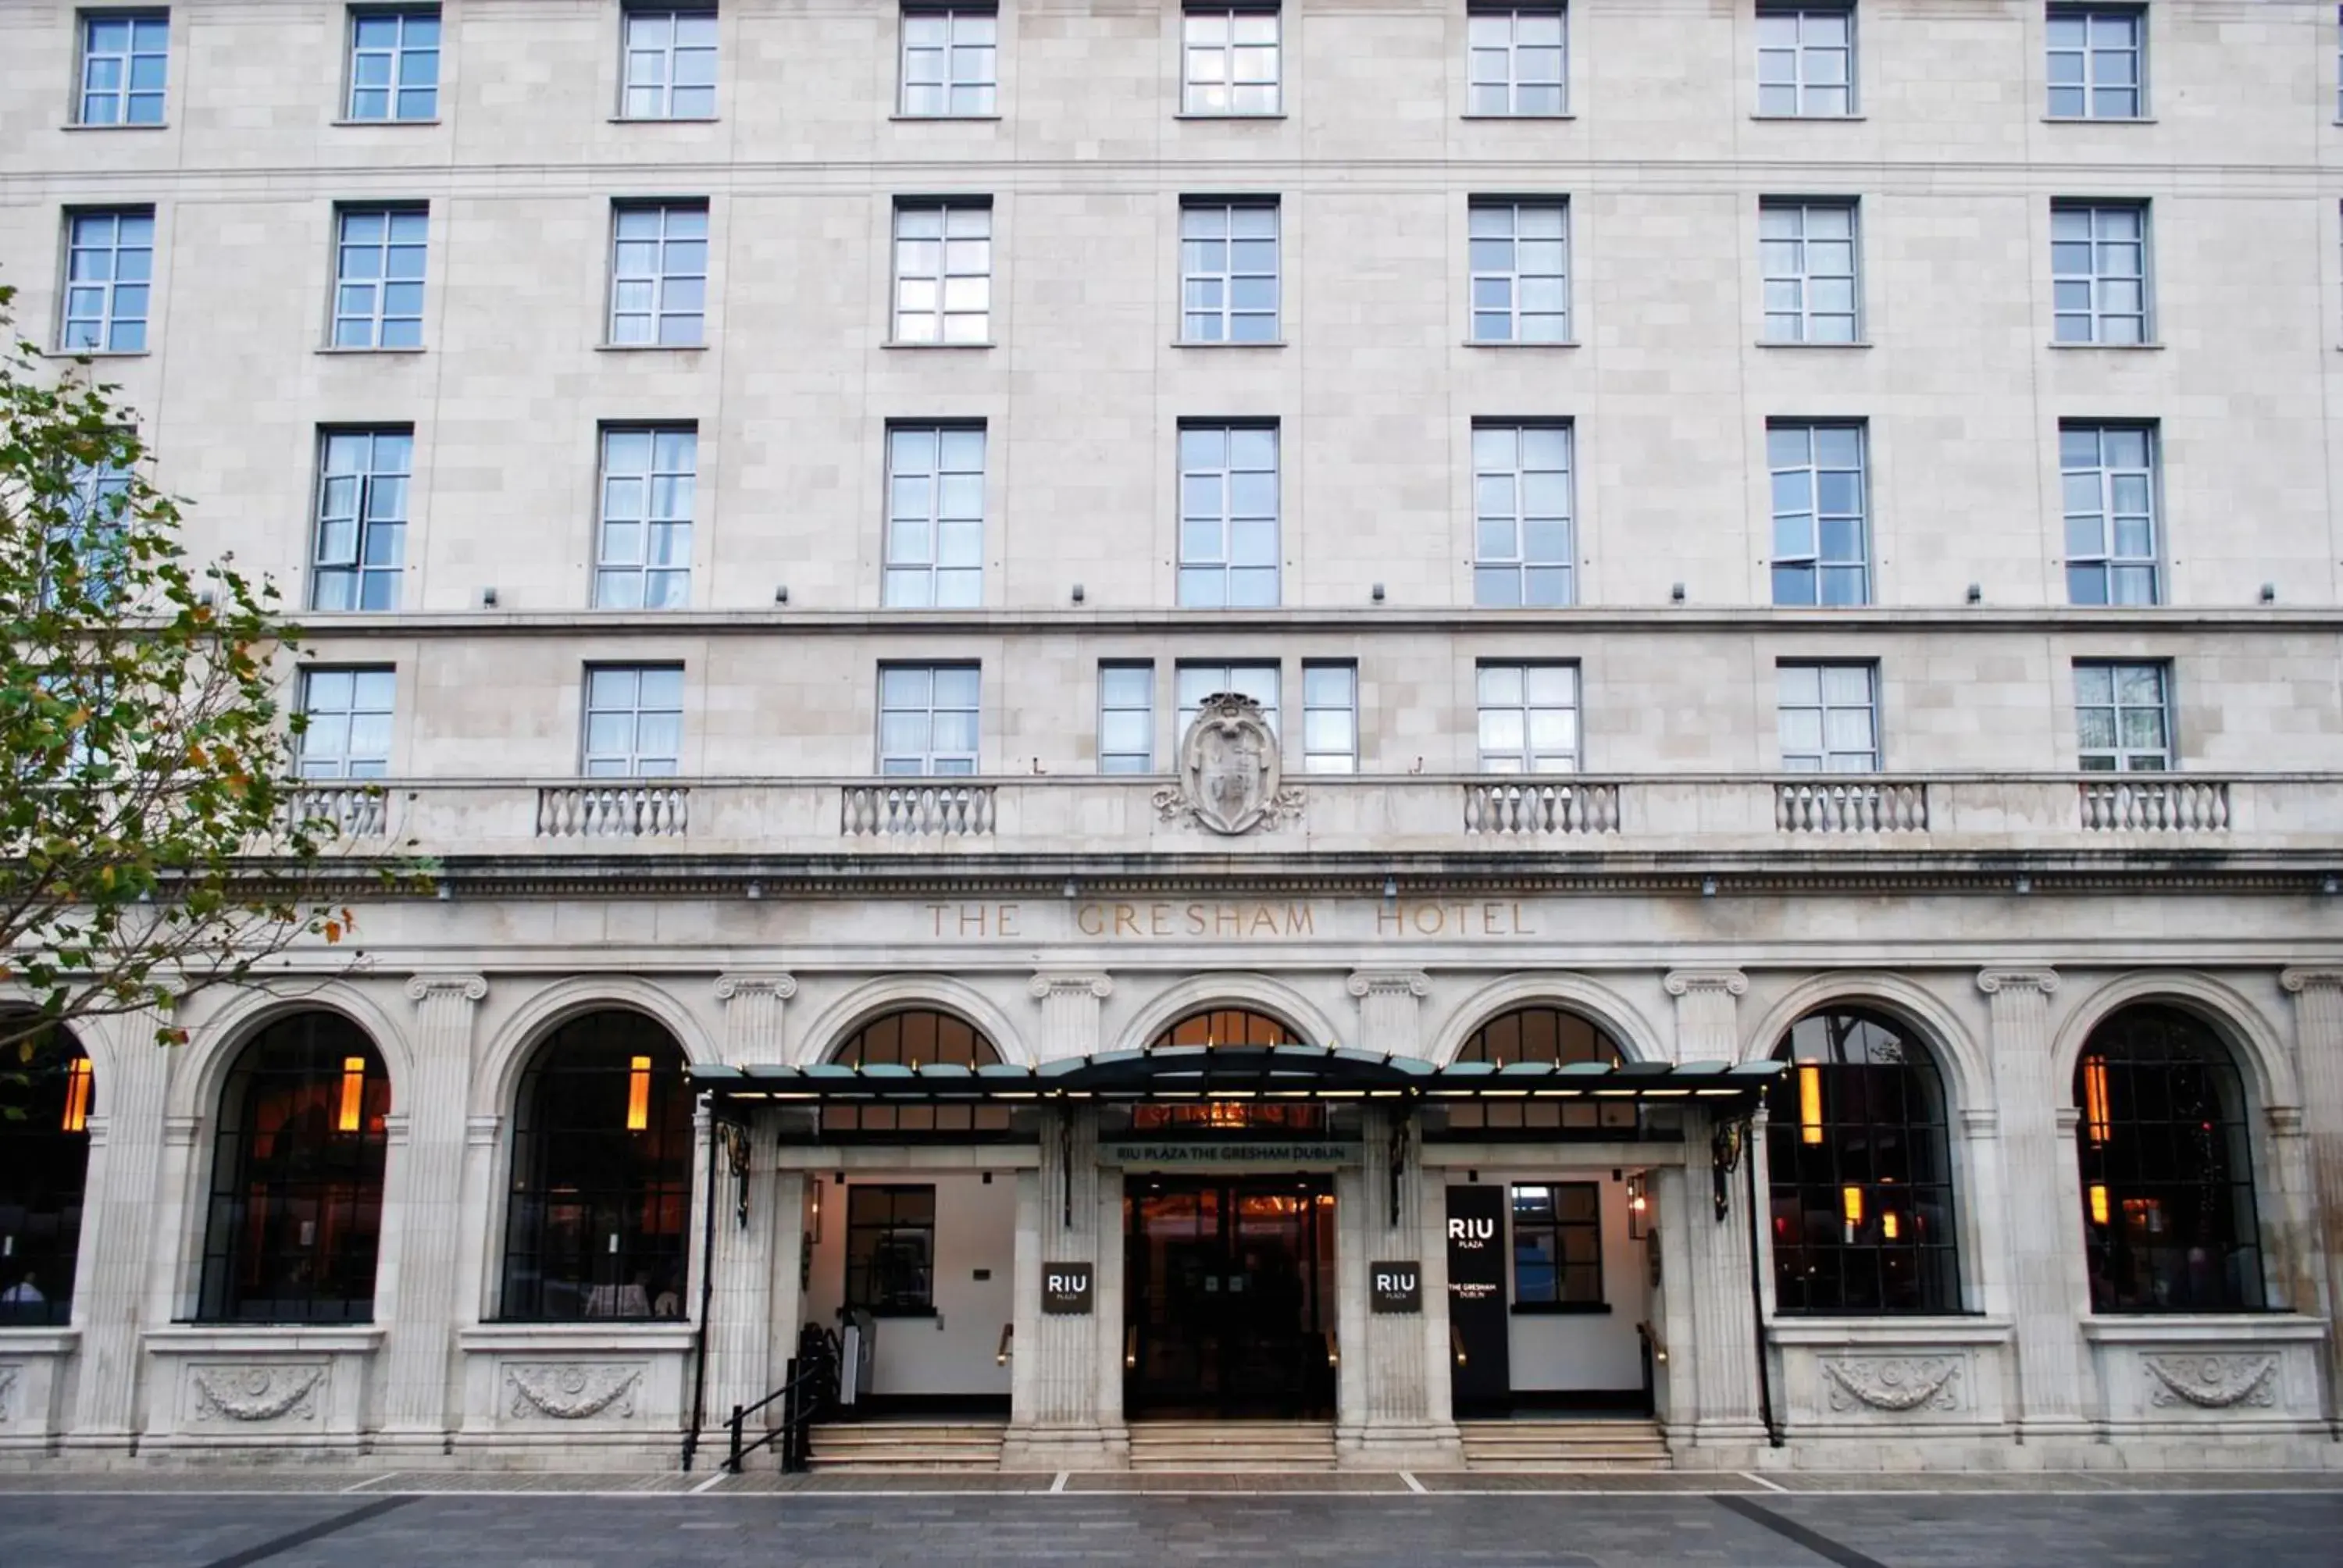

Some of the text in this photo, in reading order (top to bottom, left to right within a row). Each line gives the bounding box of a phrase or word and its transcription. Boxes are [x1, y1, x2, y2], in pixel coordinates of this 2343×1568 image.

[926, 903, 1535, 937] THE GRESHAM HOTEL
[1117, 1146, 1345, 1161] RIU PLAZA THE GRESHAM DUBLIN
[1449, 1218, 1493, 1239] RIU
[1049, 1274, 1086, 1292] RIU
[1377, 1274, 1414, 1291] RIU
